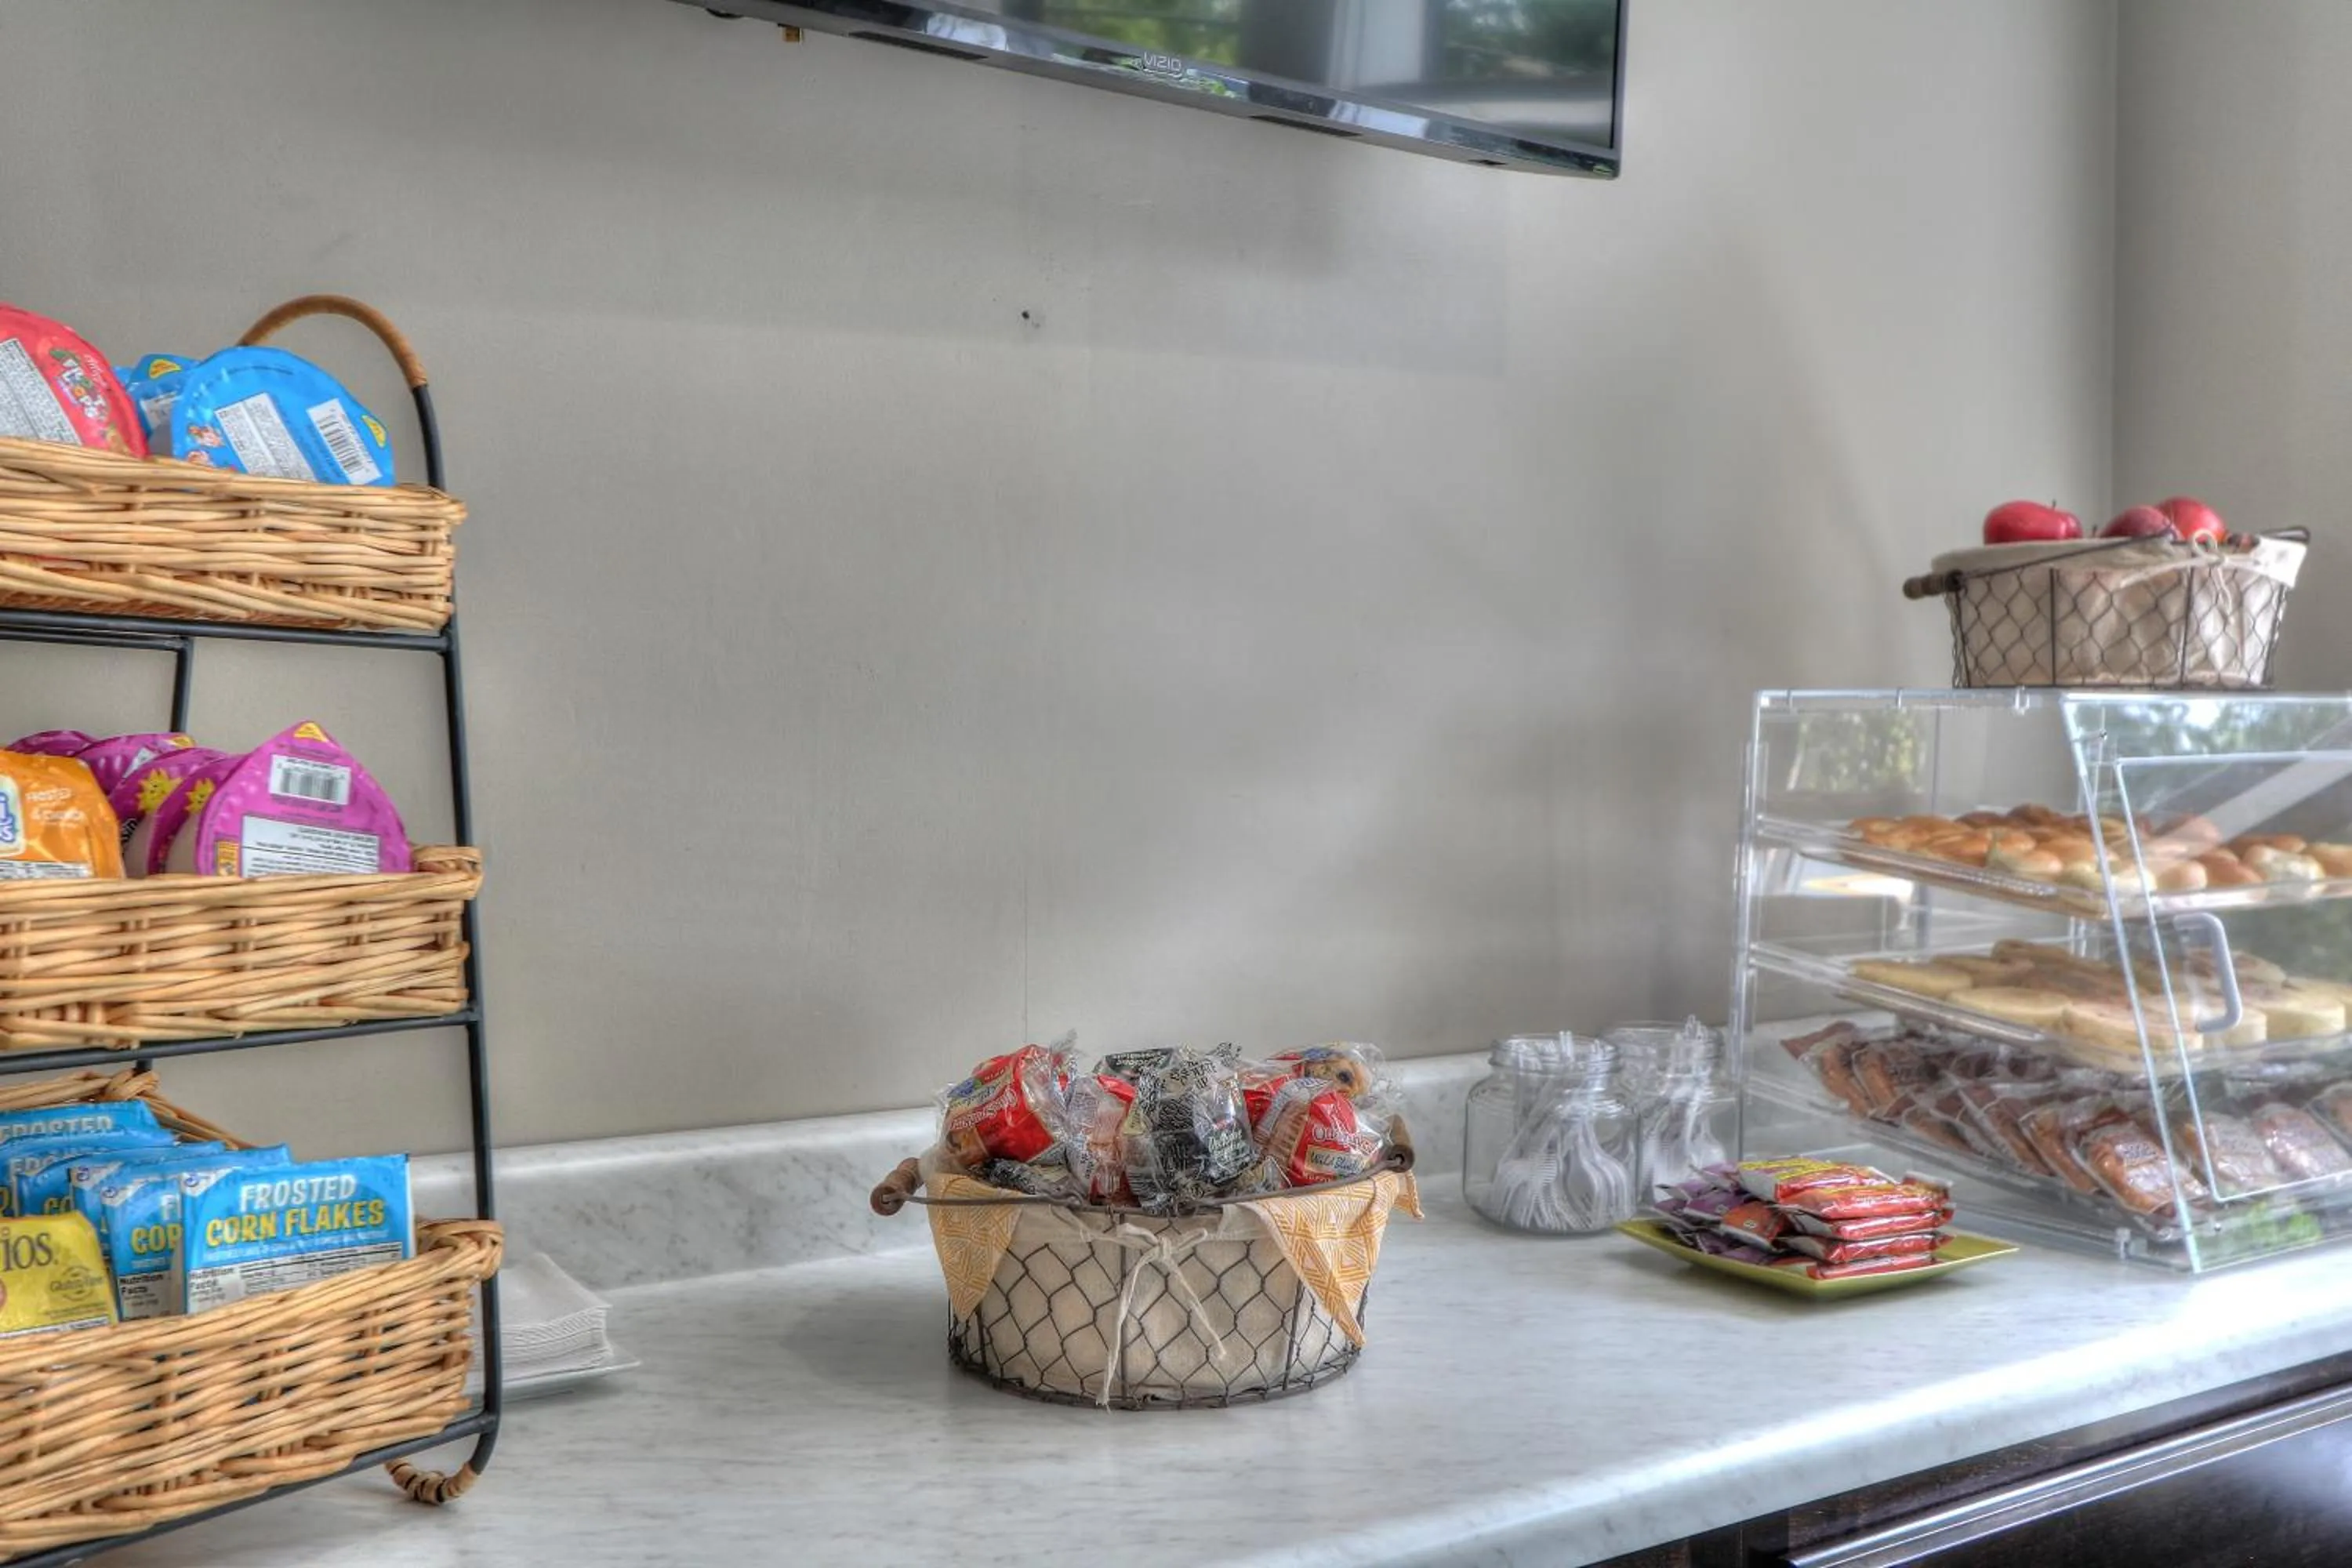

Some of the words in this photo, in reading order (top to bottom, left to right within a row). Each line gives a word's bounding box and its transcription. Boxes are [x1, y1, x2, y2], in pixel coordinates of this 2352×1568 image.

[239, 1174, 358, 1212] FROSTED
[205, 1211, 278, 1247] CORN
[284, 1199, 386, 1237] FLAKES
